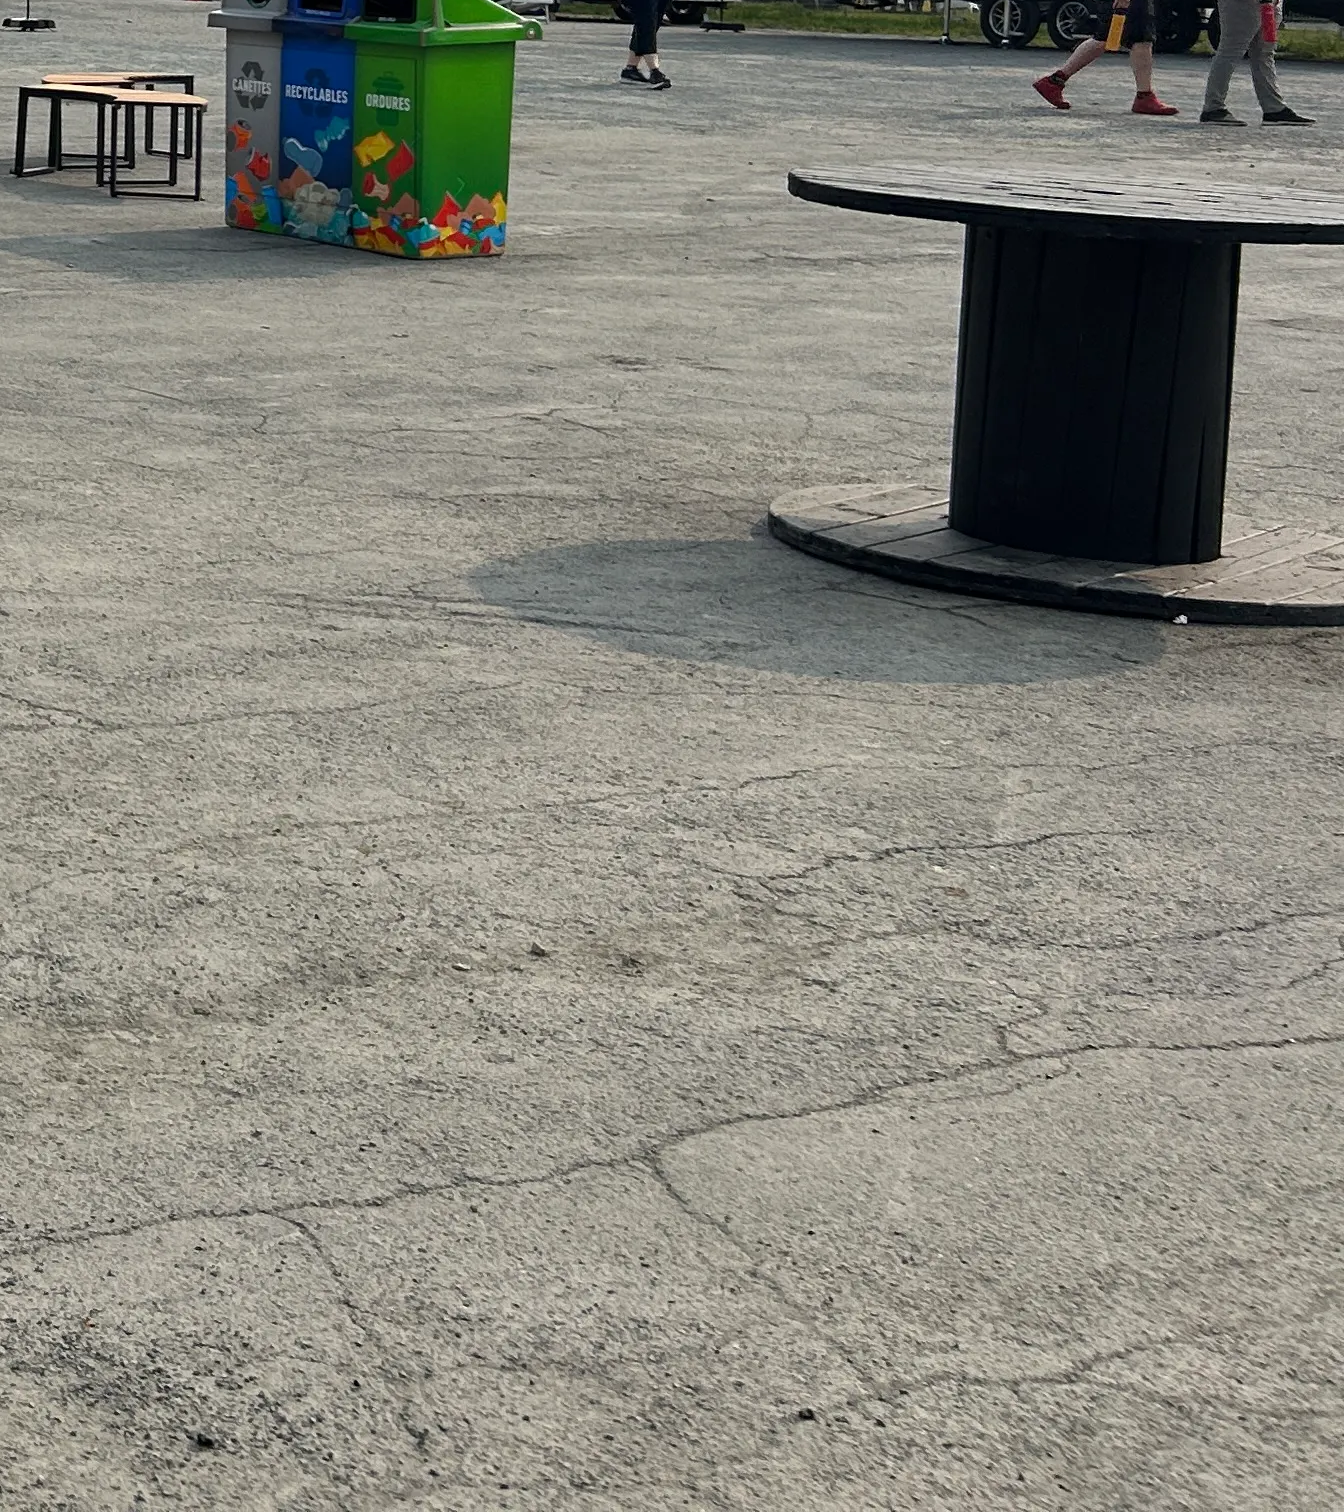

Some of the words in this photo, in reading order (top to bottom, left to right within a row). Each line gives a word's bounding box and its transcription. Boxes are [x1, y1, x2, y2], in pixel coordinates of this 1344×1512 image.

[231, 78, 273, 96] CANETTES
[285, 84, 349, 105] RECYCLABLES
[365, 93, 411, 112] ORDURES
